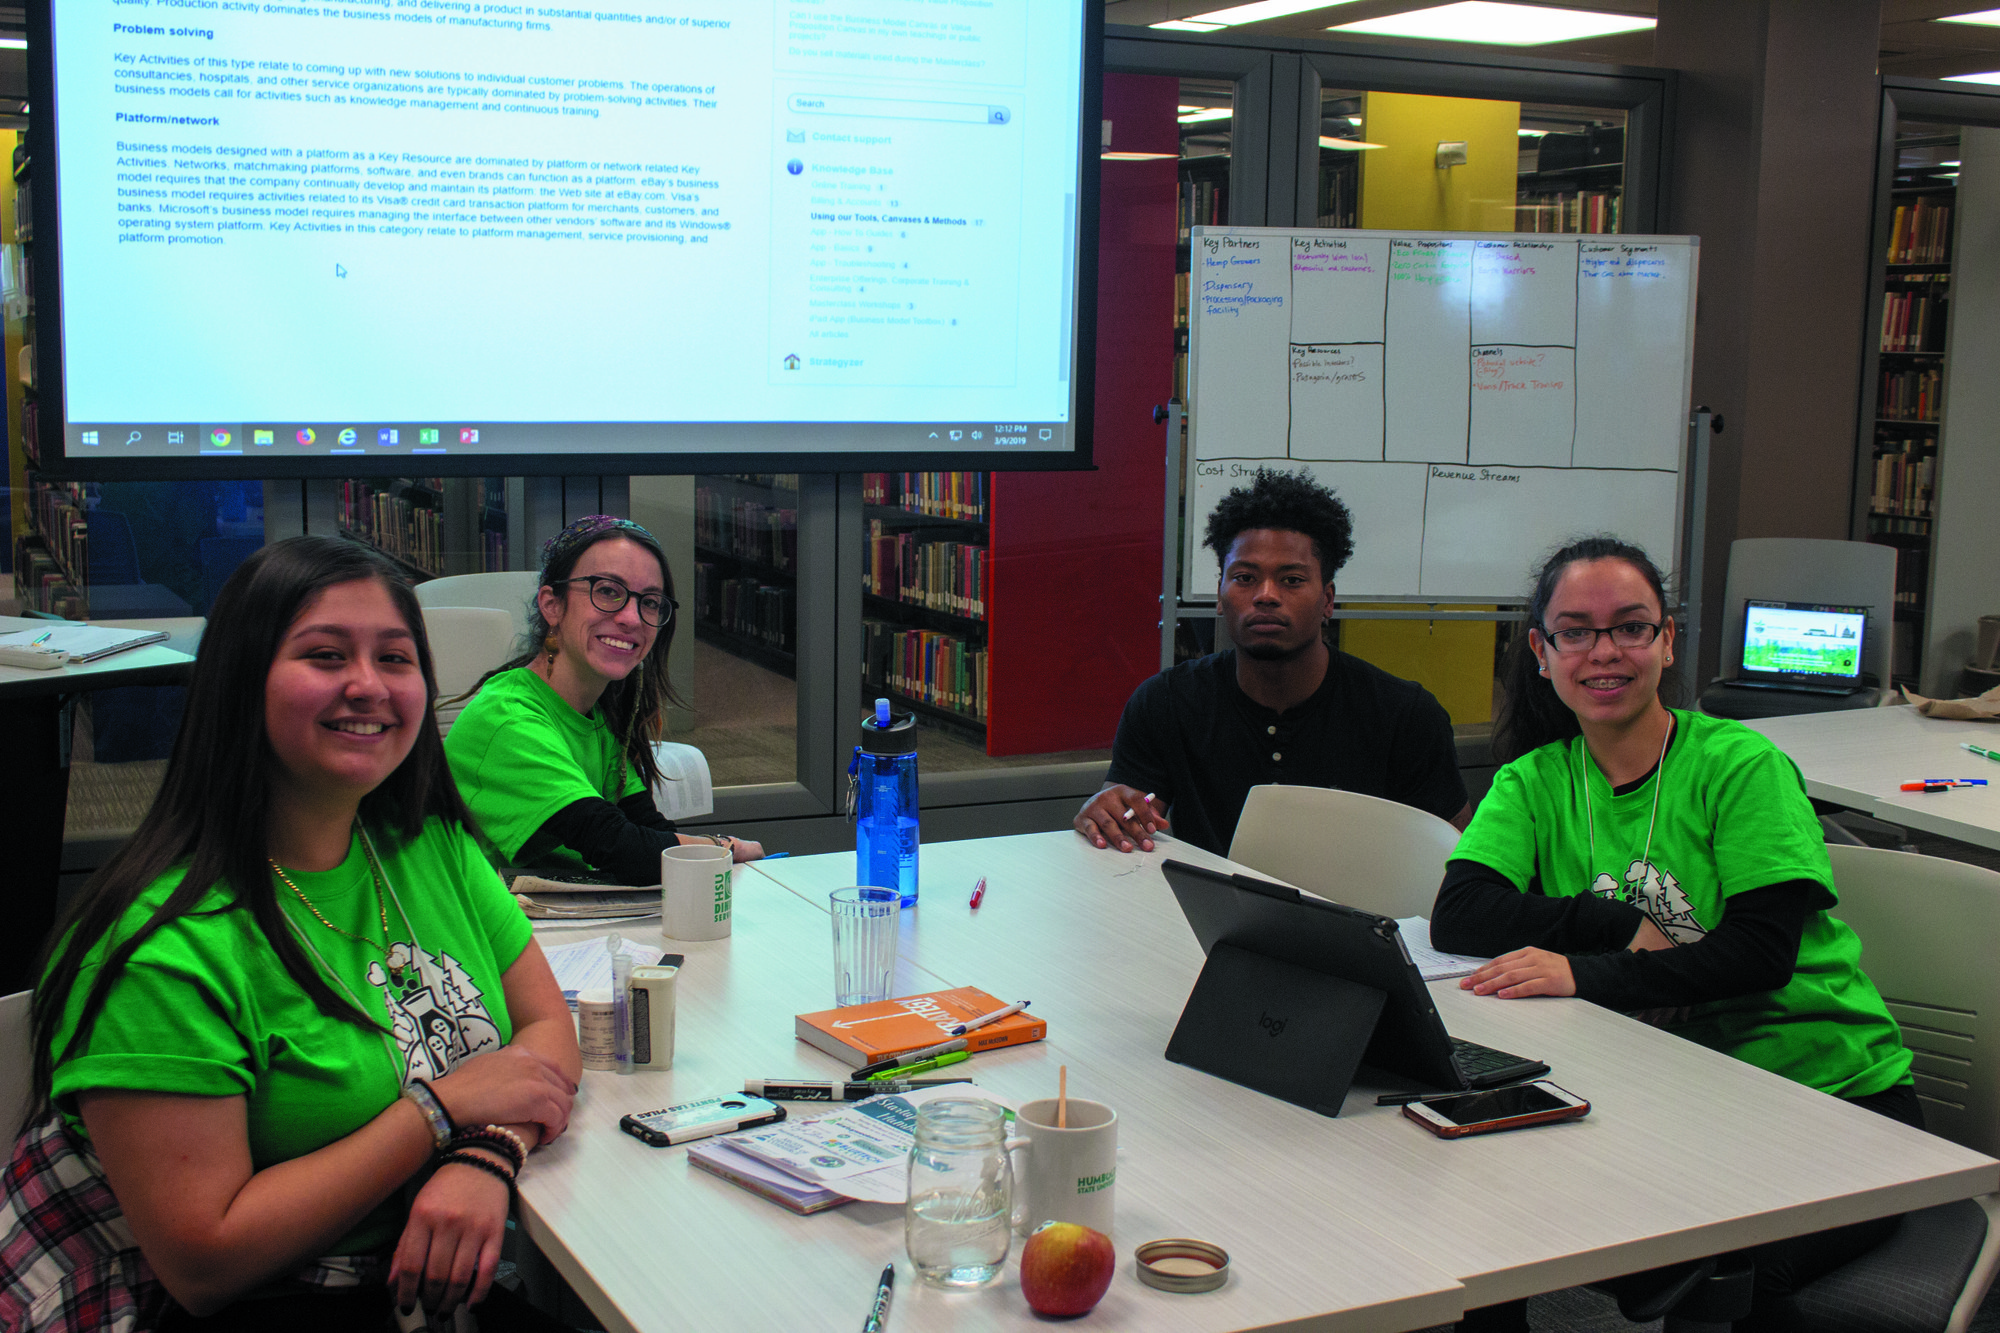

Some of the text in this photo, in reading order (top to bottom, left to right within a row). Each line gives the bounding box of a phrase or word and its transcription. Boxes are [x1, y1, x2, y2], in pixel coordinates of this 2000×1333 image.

[112, 23, 214, 40] Problem solving
[113, 52, 716, 94] Key Activities of this type relate to coming up with new solutions to individual customer problems. The operations of
[112, 69, 718, 108] consultancies, hospitals, and other service organizations are typically dominated by problem-solving activities. Their
[113, 84, 603, 118] business models call for activities such as knowledge management and continuous training.
[796, 99, 825, 109] Search
[114, 113, 220, 125] Platform/network
[812, 132, 892, 146] Contact support
[115, 141, 701, 175] Business models designed with a platform as a Key Resource are dominated by platform or network related Key
[811, 163, 894, 176] Knowledge Base
[810, 212, 836, 224] Using
[854, 213, 879, 223] Tools,
[881, 215, 922, 224] Canvases
[923, 216, 931, 224] &
[932, 216, 967, 226] Methods
[117, 233, 227, 245] platform promotion.
[1203, 237, 1260, 254] Key Partners
[1294, 238, 1311, 253] Key
[1580, 244, 1615, 253] Customer
[1206, 257, 1228, 269] Hemp
[1292, 346, 1306, 358] Key
[809, 356, 864, 368] Strategyzer
[994, 424, 1028, 433] 12:12 PM
[994, 437, 1027, 445] 3/9/2019
[1196, 462, 1225, 476] Cost
[1432, 466, 1521, 483] Revenue Streams
[714, 873, 725, 903] HSU
[1258, 1011, 1289, 1038] logi
[636, 1107, 668, 1119] PILAS
[669, 1104, 688, 1113] LAS
